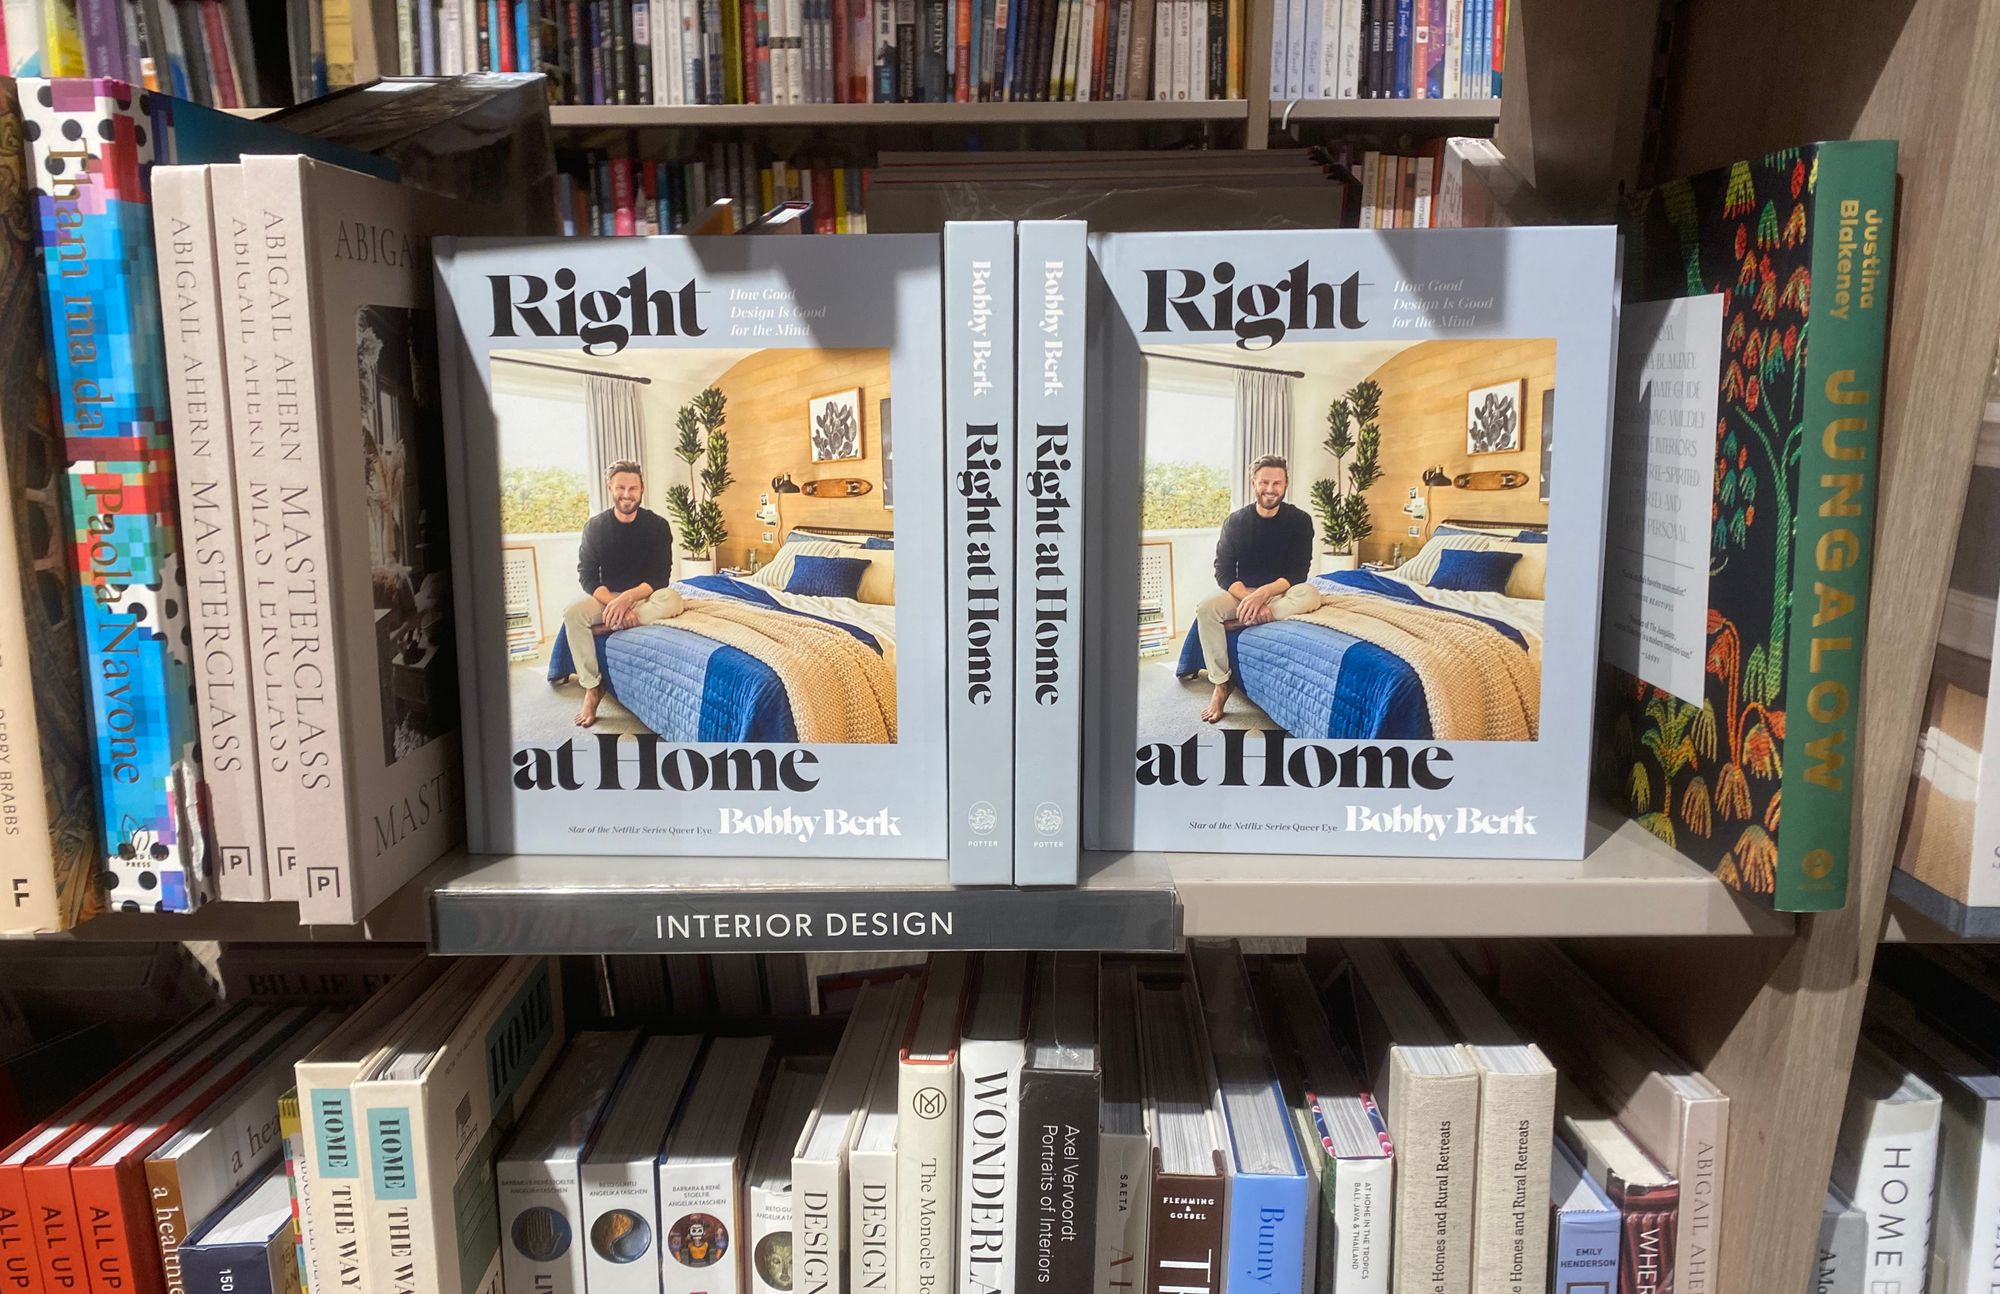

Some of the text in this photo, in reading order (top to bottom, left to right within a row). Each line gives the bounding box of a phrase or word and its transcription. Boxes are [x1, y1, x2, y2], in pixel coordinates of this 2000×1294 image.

[1393, 279, 1464, 293] How Good
[1829, 199, 1860, 321] Blakeney
[1860, 209, 1883, 309] Justina
[486, 266, 711, 357] Right
[729, 287, 796, 302] How Good
[730, 305, 826, 321] Design Is Good
[1141, 259, 1375, 351] Right
[1392, 313, 1475, 329] for the Mind
[1393, 296, 1493, 313] Design Is Good
[64, 293, 97, 365] ma
[729, 322, 810, 338] for the Mind
[73, 378, 115, 432] da
[171, 217, 242, 772] ABIGAIL AHERN MASTERCLASS
[263, 208, 330, 790] ABIGAIL AHERN MASTERCLASS
[957, 260, 1002, 706] Bobby Berk Right at Home
[1026, 260, 1071, 706] Bobby Berk Right at Home
[85, 486, 133, 605] Paola
[1804, 369, 1870, 792] JUNGALOW
[99, 619, 140, 784] Navone
[512, 733, 821, 793] at Home
[1135, 729, 1454, 790] at Home
[568, 825, 712, 837] Star of the Netflix Series Queer Eye
[718, 806, 901, 843] Bobby Berk
[1188, 821, 1338, 835] Star of the Netflix Series Queer Eye
[1345, 804, 1538, 841] Bobby Berk
[126, 861, 151, 869] PRESS
[656, 911, 954, 940] INTERIOR DESIGN
[322, 1100, 348, 1168] HOME
[379, 1119, 405, 1189] HOME
[152, 1187, 169, 1199] a
[920, 1158, 937, 1193] The
[1038, 1125, 1059, 1283] Portraits of Interiors
[1061, 1124, 1081, 1242] Axel Vervoordt
[1118, 1174, 1128, 1212] SAETA
[1163, 1197, 1215, 1206] FLEMMING
[1364, 1182, 1371, 1192] AT
[1432, 1120, 1451, 1282] Homes and Rural Retreats
[1510, 1119, 1529, 1282] Homes and Rural Retreats
[1874, 1148, 1912, 1266] HOME
[0, 1207, 29, 1289] ALL UP
[41, 1206, 75, 1289] ALL UP
[89, 1206, 122, 1290] ALL UP
[332, 1185, 361, 1291] THE WAY
[388, 1206, 412, 1257] THE
[804, 1190, 828, 1294] DESIGN
[862, 1183, 887, 1290] DESIGN
[919, 1198, 936, 1269] Monocle
[1170, 1212, 1206, 1220] GOEBEL
[1246, 1207, 1285, 1286] Bunny
[1363, 1219, 1370, 1229] IN
[1687, 1141, 1714, 1294] ABIGAIL AHE
[219, 1268, 234, 1292] 150
[1351, 1231, 1359, 1270] THAILAND
[1362, 1247, 1370, 1280] TROPICS
[1560, 1259, 1616, 1268] HENDERSON
[1576, 1248, 1603, 1256] EMILY
